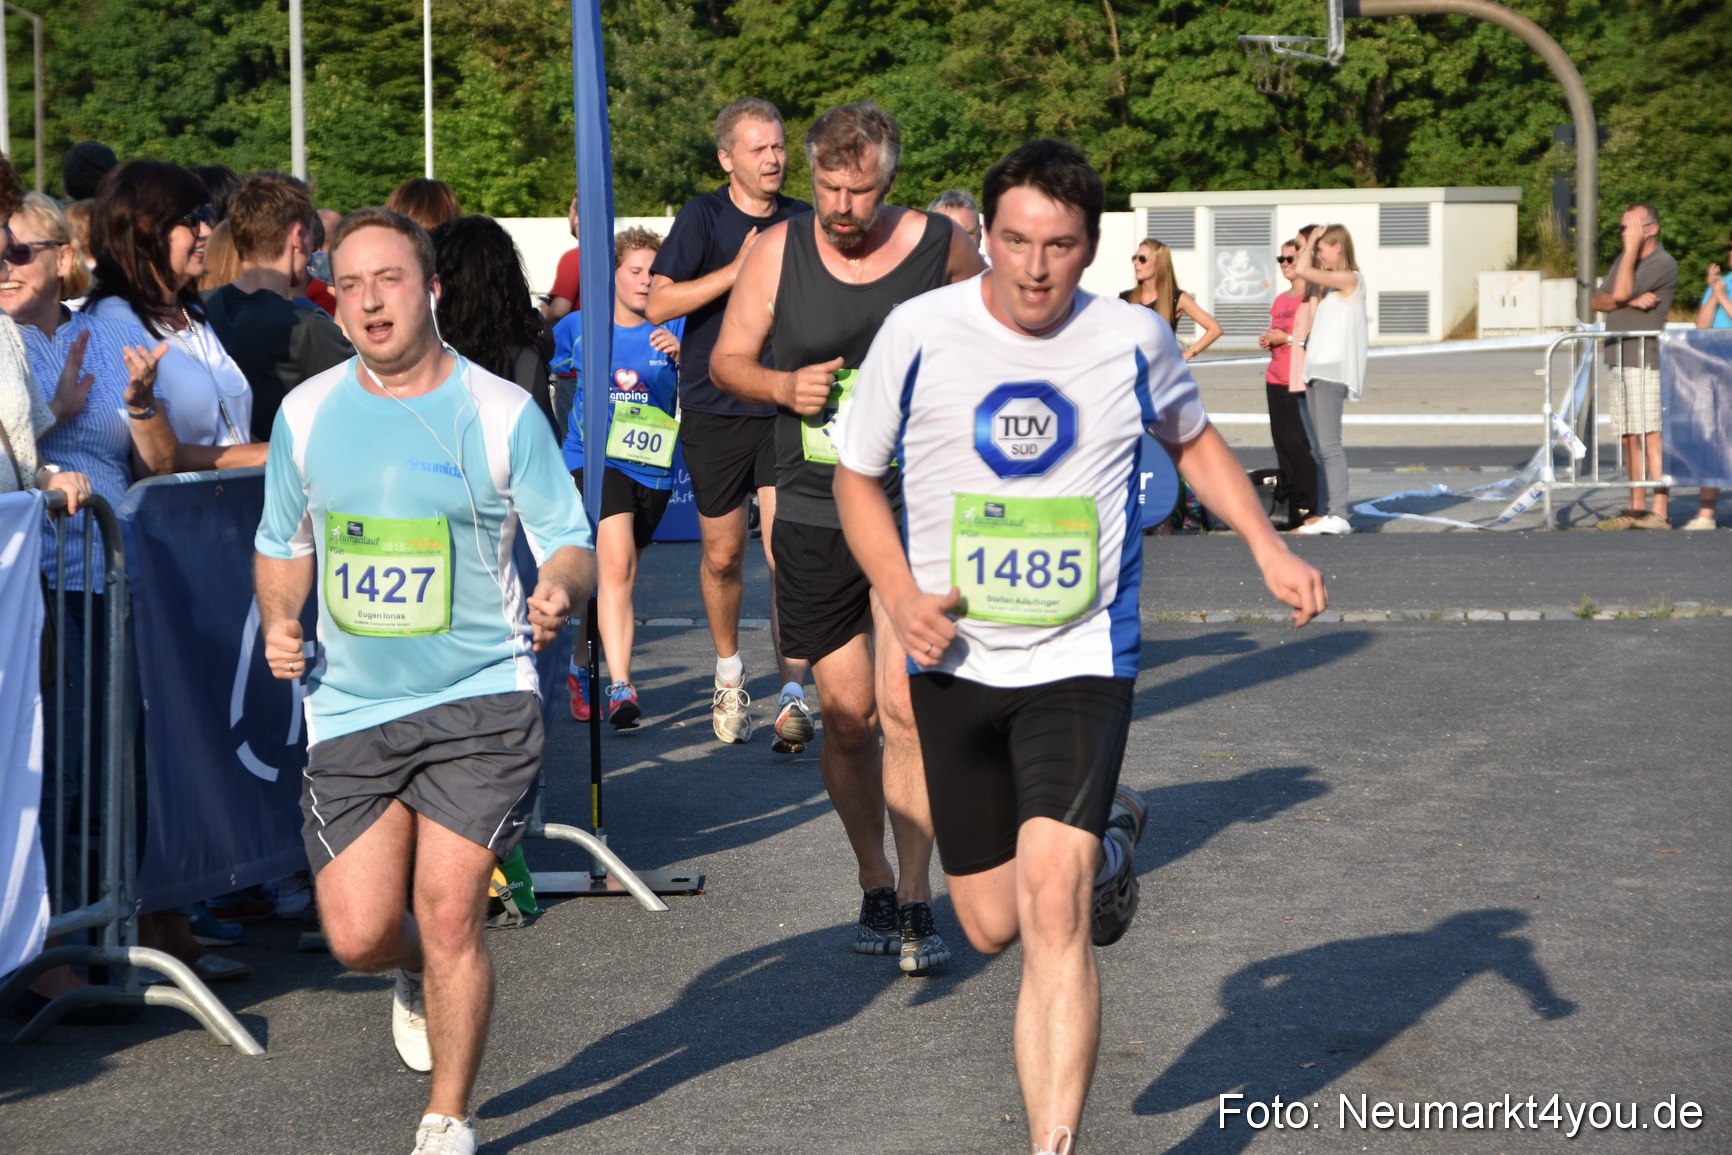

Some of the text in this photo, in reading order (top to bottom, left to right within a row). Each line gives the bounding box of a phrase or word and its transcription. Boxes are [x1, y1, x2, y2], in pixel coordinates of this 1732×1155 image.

[609, 390, 648, 403] amping
[998, 415, 1052, 437] TÜV
[622, 428, 662, 453] 490
[1011, 442, 1038, 455] SÜD
[967, 547, 1082, 588] 1485
[335, 562, 435, 603] 1427
[986, 594, 1014, 603] Stefan
[358, 610, 381, 620] Eugen
